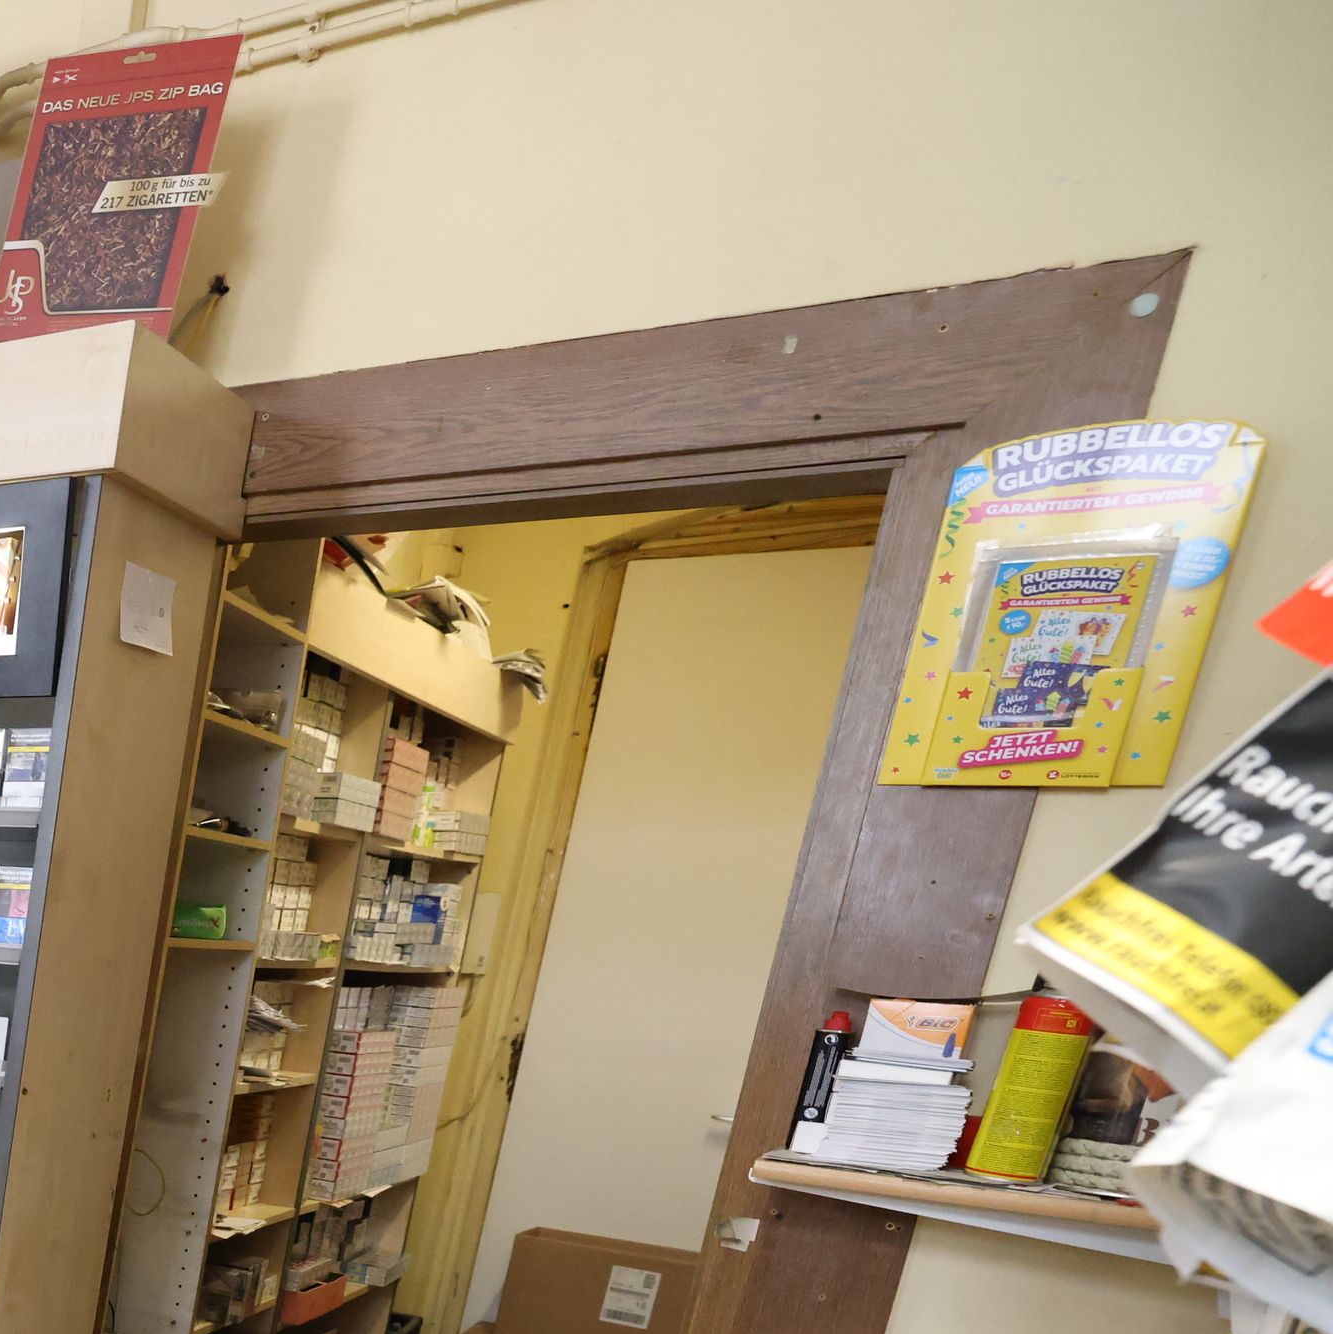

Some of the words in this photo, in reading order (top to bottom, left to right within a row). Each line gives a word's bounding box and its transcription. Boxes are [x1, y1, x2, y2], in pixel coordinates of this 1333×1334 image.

[42, 100, 73, 113] DAS
[77, 94, 120, 110] NEUE
[124, 90, 154, 104] JPS
[157, 86, 185, 101] ZIP
[188, 82, 223, 97] BAG
[130, 181, 150, 191] 100
[161, 177, 177, 188] für
[180, 176, 194, 187] bis
[197, 178, 210, 186] zu
[100, 195, 122, 209] 217
[997, 422, 1227, 469] RUBBELLOS
[998, 454, 1212, 491] GLÜCKSPAKET
[986, 496, 1120, 514] GARANTIERTEM
[1125, 487, 1204, 505] GEWINN!
[1023, 568, 1122, 584] RUBBELLOS
[1023, 581, 1115, 594] GLÜCKSPAKET
[1033, 669, 1056, 677] Alles
[1024, 676, 1053, 688] Gute!
[990, 732, 1052, 748] JETZT
[962, 741, 1078, 763] SCHENKEN!
[1171, 785, 1263, 850] Ihre
